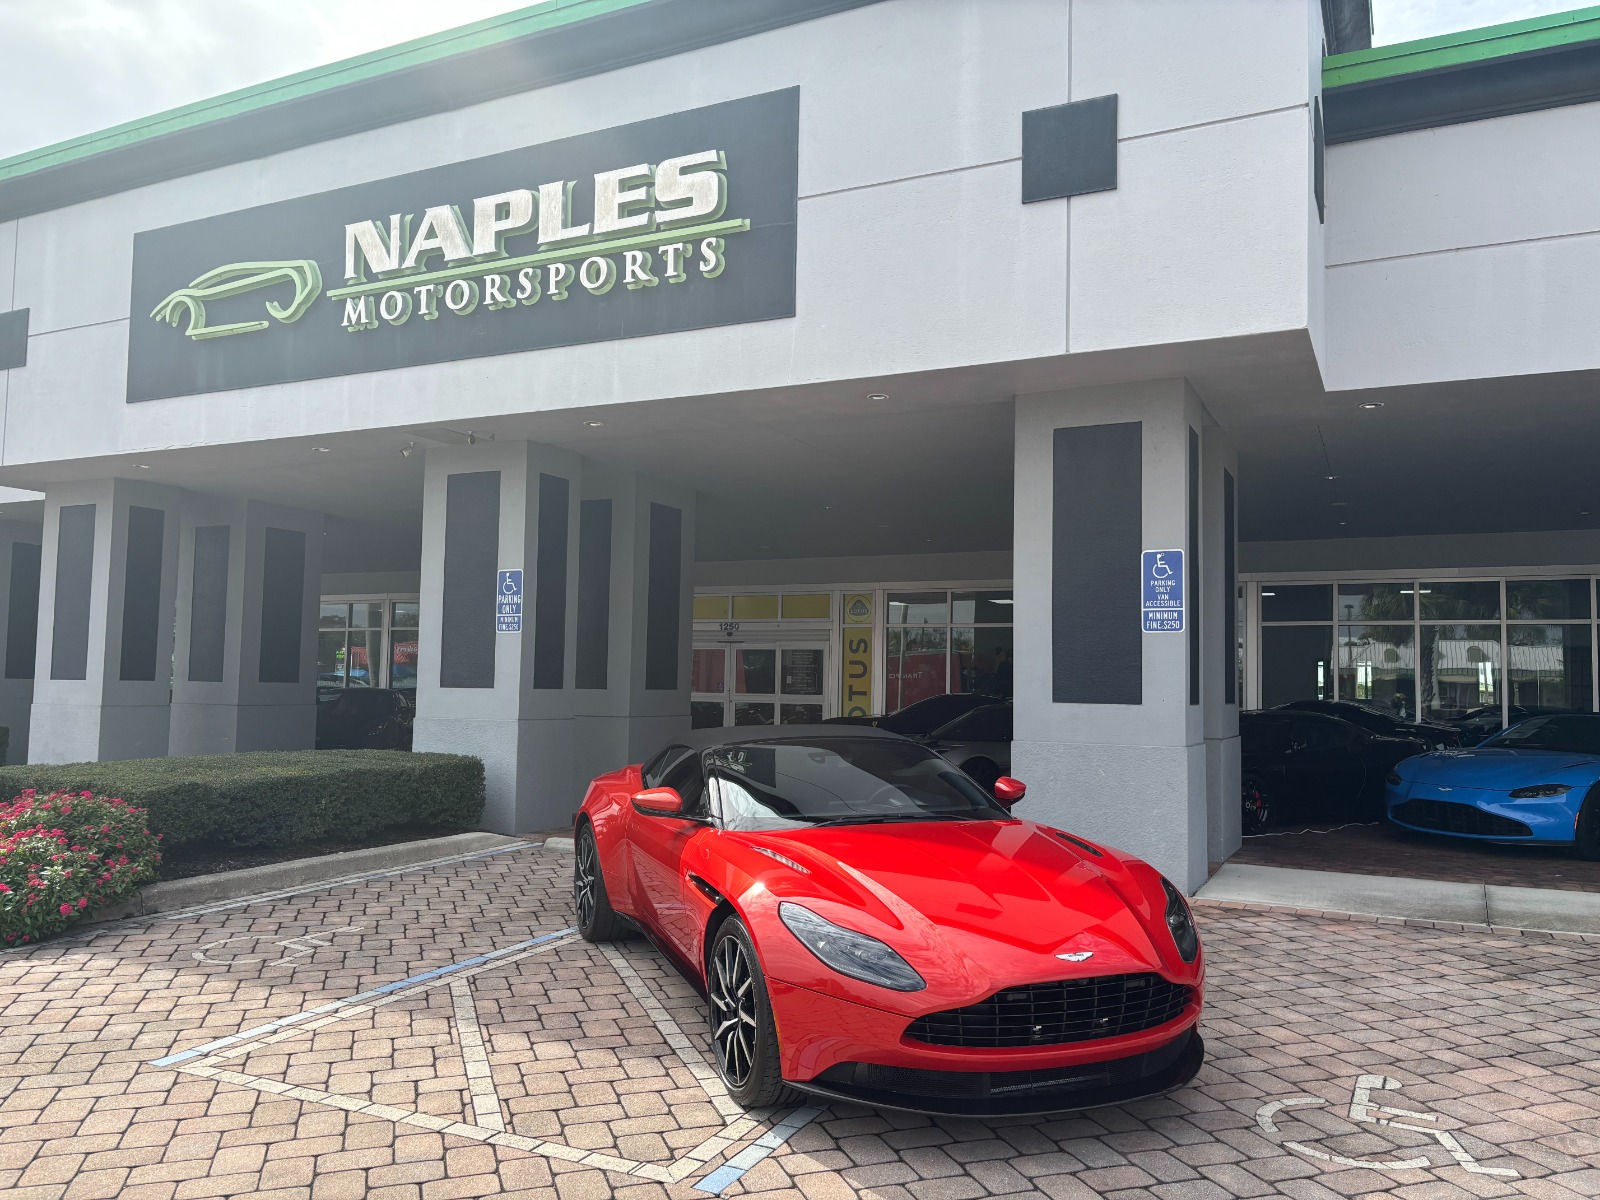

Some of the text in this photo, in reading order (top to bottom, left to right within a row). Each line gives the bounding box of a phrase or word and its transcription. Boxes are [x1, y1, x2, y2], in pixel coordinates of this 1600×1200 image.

[343, 149, 726, 284] NAPLES
[340, 237, 725, 331] MOTORSPORTS
[499, 595, 521, 603] PARKING
[502, 604, 517, 613] ONLY
[718, 623, 740, 631] 1250
[1147, 621, 1180, 629] FINE $250
